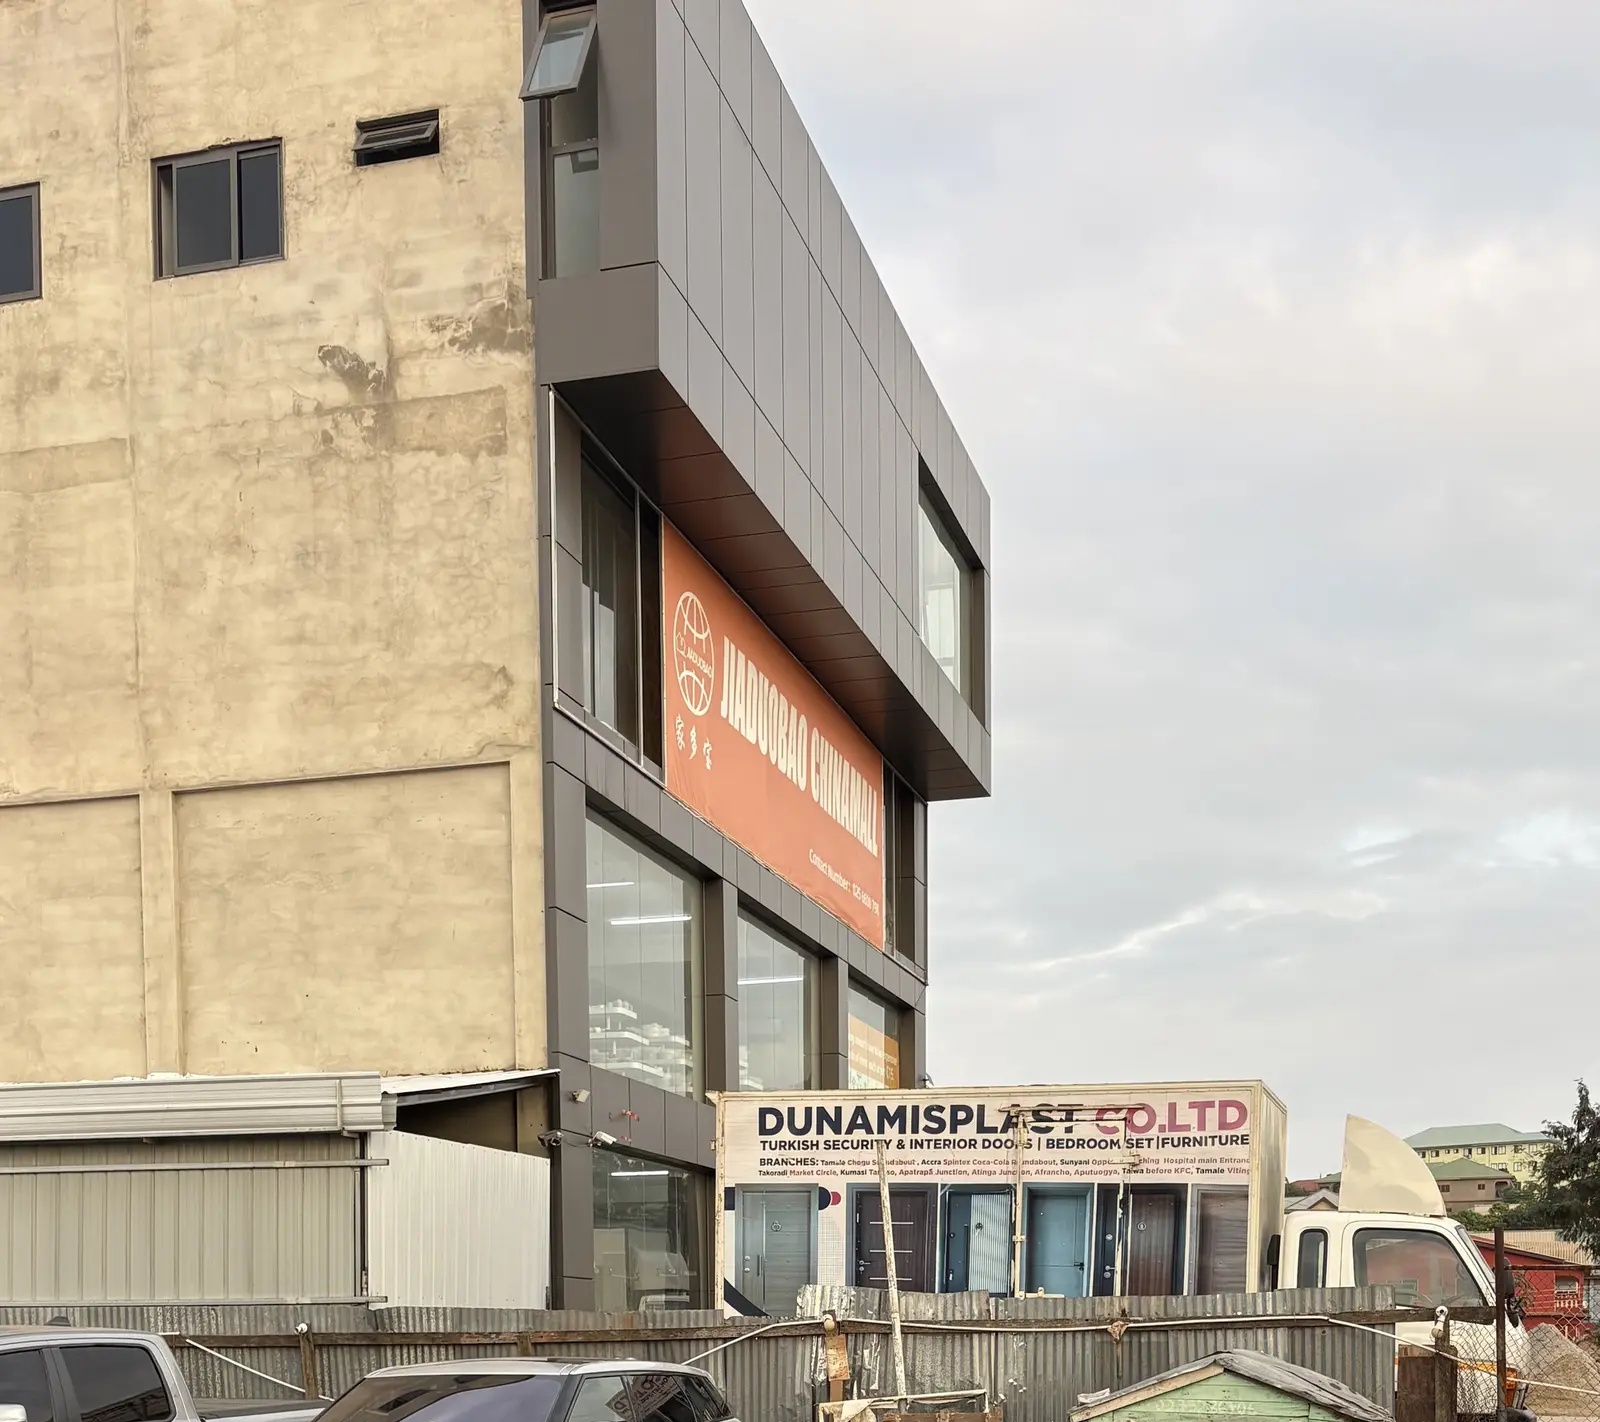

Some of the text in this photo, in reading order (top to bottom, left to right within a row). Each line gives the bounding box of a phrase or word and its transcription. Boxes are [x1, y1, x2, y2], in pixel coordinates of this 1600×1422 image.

[720, 635, 878, 858] JIADUOBAO CHINAMALL
[758, 1103, 1084, 1136] DUNAMISPLAST
[760, 1140, 819, 1151] TURKISH
[896, 1139, 905, 1150] &
[910, 1139, 978, 1150] INTERIOR
[982, 1138, 1033, 1150] DOOS
[1046, 1138, 1121, 1150] BEDROOM
[759, 1158, 819, 1167] BRANCHES:
[943, 1159, 970, 1167] Spintex
[1060, 1158, 1090, 1167] Sunyani
[1164, 1156, 1196, 1165] Hospital
[1198, 1156, 1218, 1164] main
[815, 1169, 839, 1177] Circle,
[935, 1168, 969, 1177] Junction,
[971, 1168, 997, 1177] Atinga
[1034, 1168, 1072, 1177] Afrancho,
[1145, 1167, 1172, 1175] before
[1174, 1167, 1193, 1176] KFC,
[1196, 1167, 1225, 1175] Tamale
